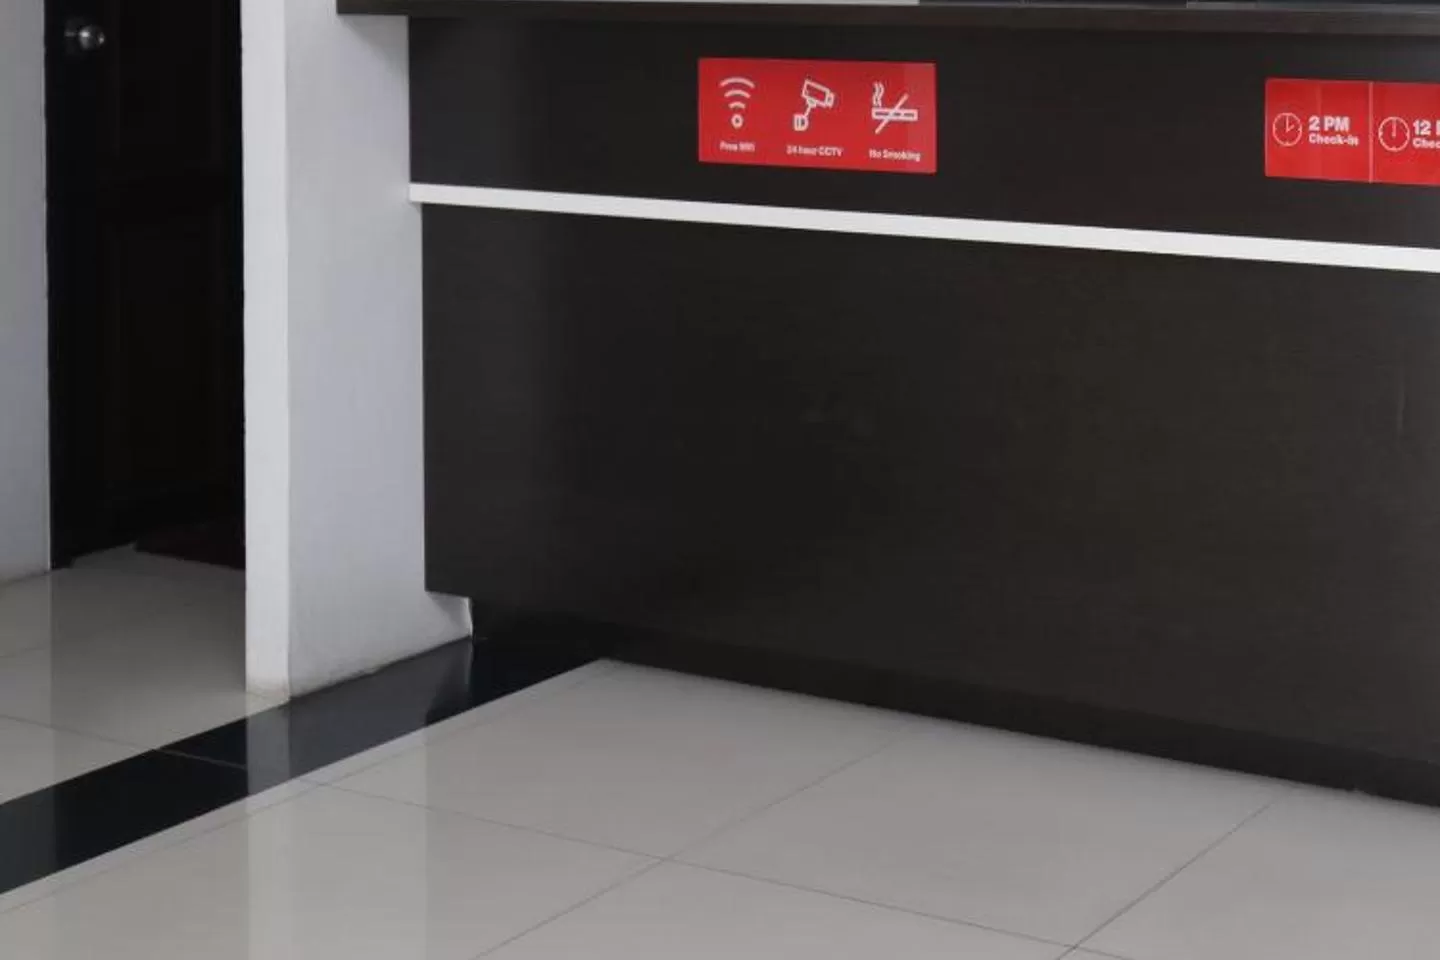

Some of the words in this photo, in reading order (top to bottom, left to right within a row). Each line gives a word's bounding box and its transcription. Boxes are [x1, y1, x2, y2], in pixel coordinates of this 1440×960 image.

[1308, 114, 1320, 131] 2
[1323, 114, 1350, 132] PM
[1412, 119, 1432, 136] 12
[1308, 132, 1360, 147] Check-in
[819, 145, 843, 157] CCTV
[869, 147, 882, 159] No
[883, 148, 922, 163] Smoking
